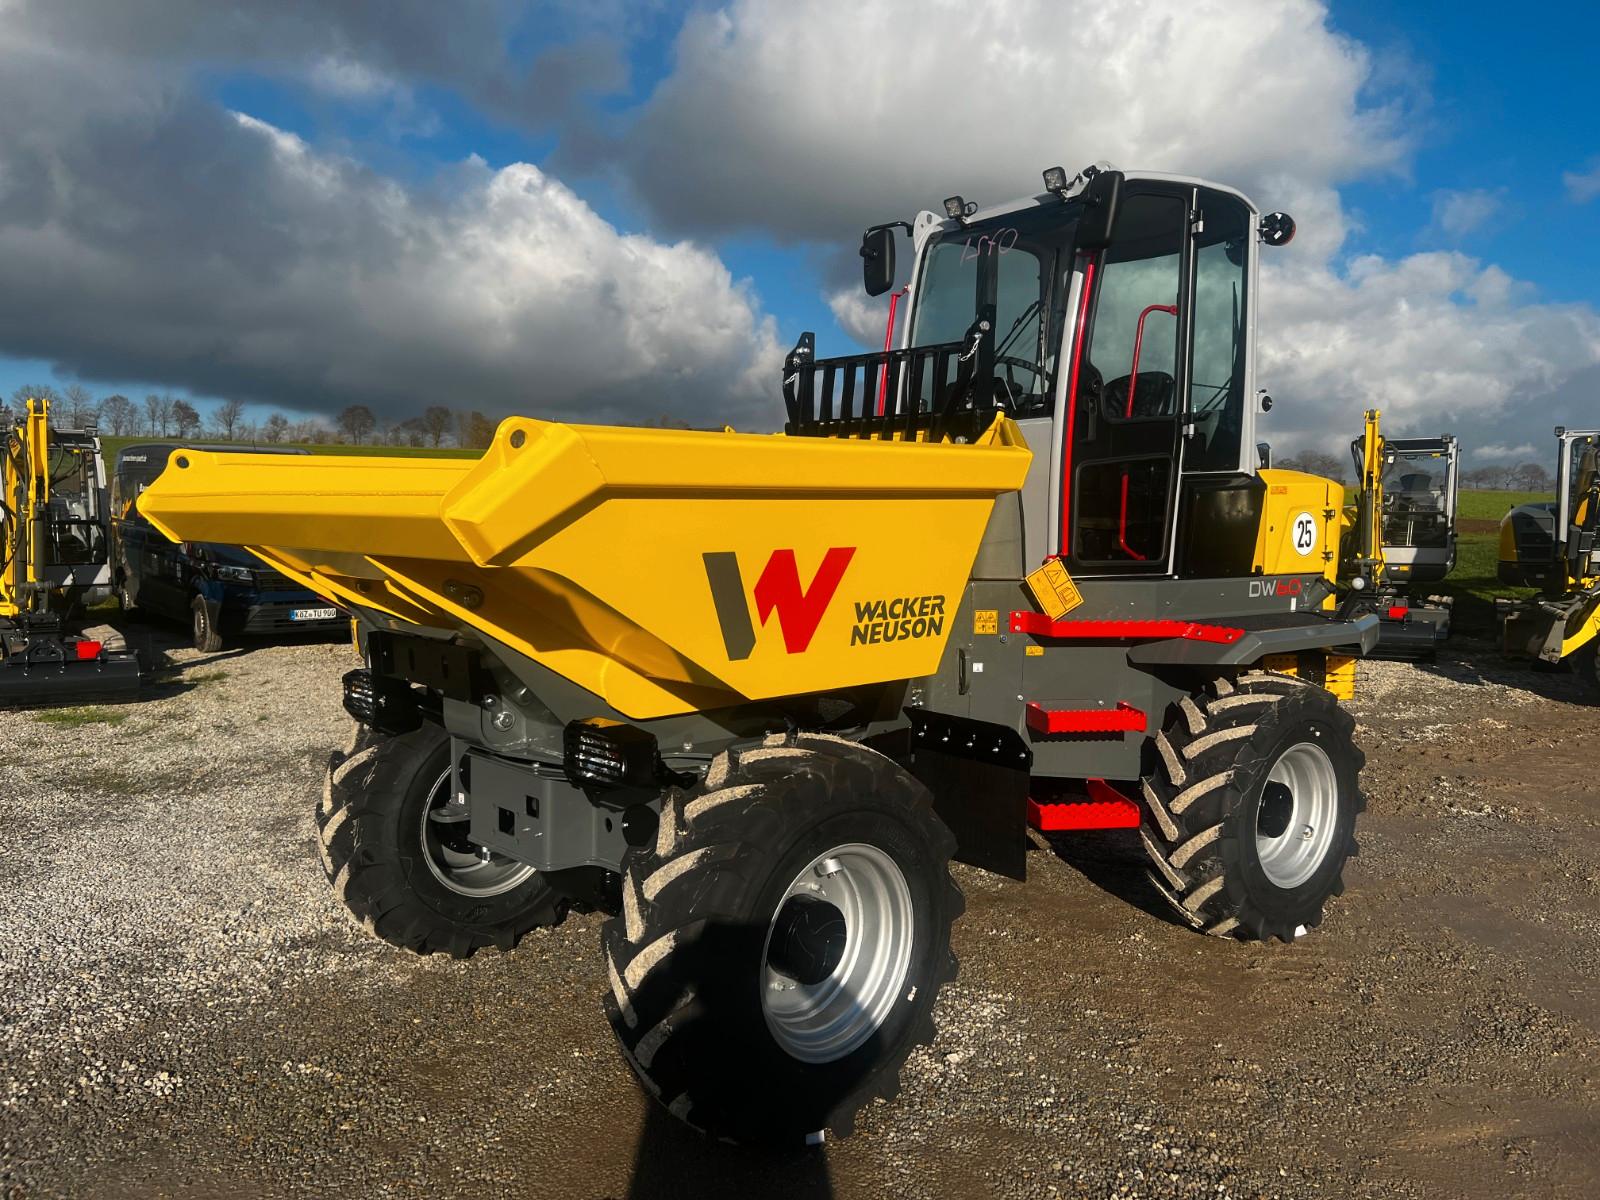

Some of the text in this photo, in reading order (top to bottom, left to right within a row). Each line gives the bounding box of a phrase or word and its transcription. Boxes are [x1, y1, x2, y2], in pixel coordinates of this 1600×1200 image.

[1297, 519, 1312, 548] 25
[854, 595, 946, 623] WACKER
[850, 615, 944, 647] NEUSON
